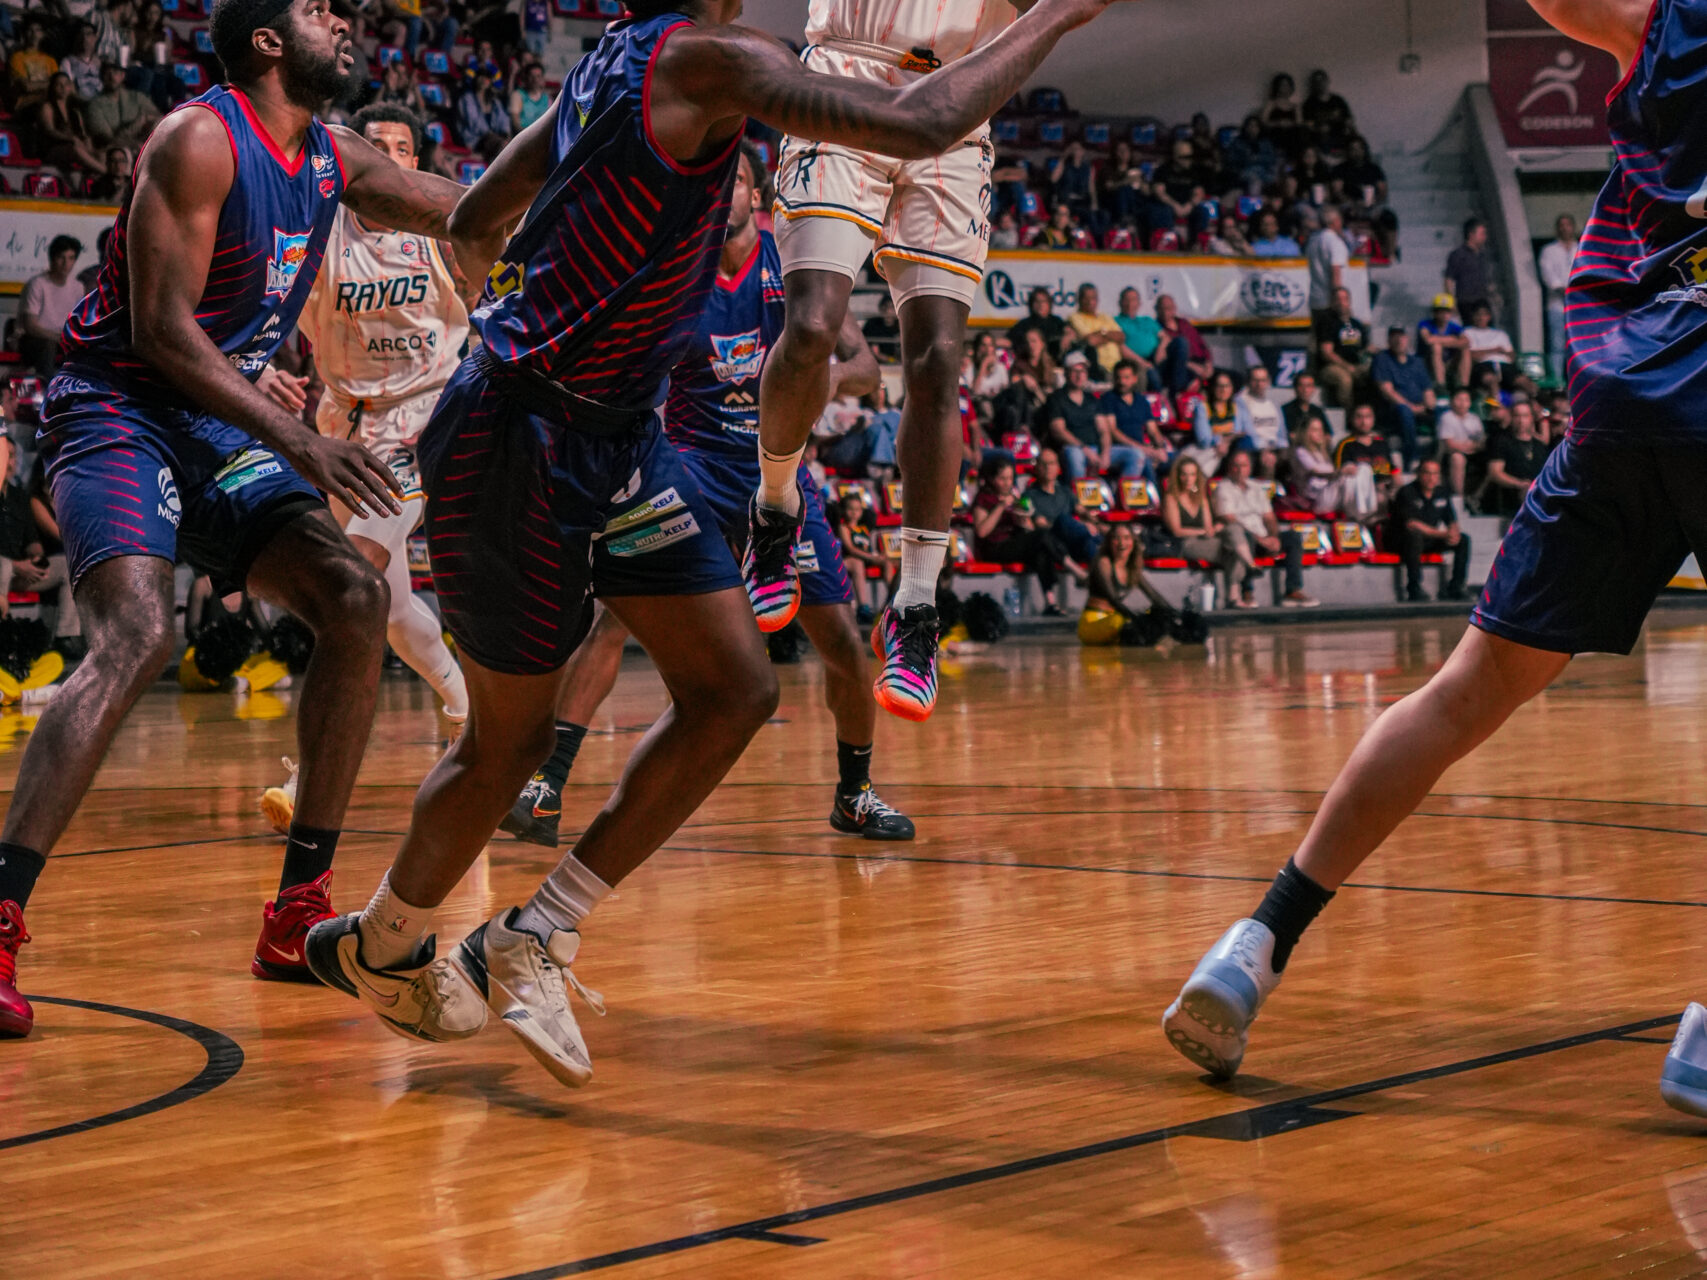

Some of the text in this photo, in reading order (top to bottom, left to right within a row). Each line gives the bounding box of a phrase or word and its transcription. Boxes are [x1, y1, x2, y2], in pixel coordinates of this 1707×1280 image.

[967, 218, 990, 241] ME
[335, 273, 430, 321] RAYOS
[367, 334, 423, 352] ARCO
[634, 519, 693, 548] NUTRIKELP
